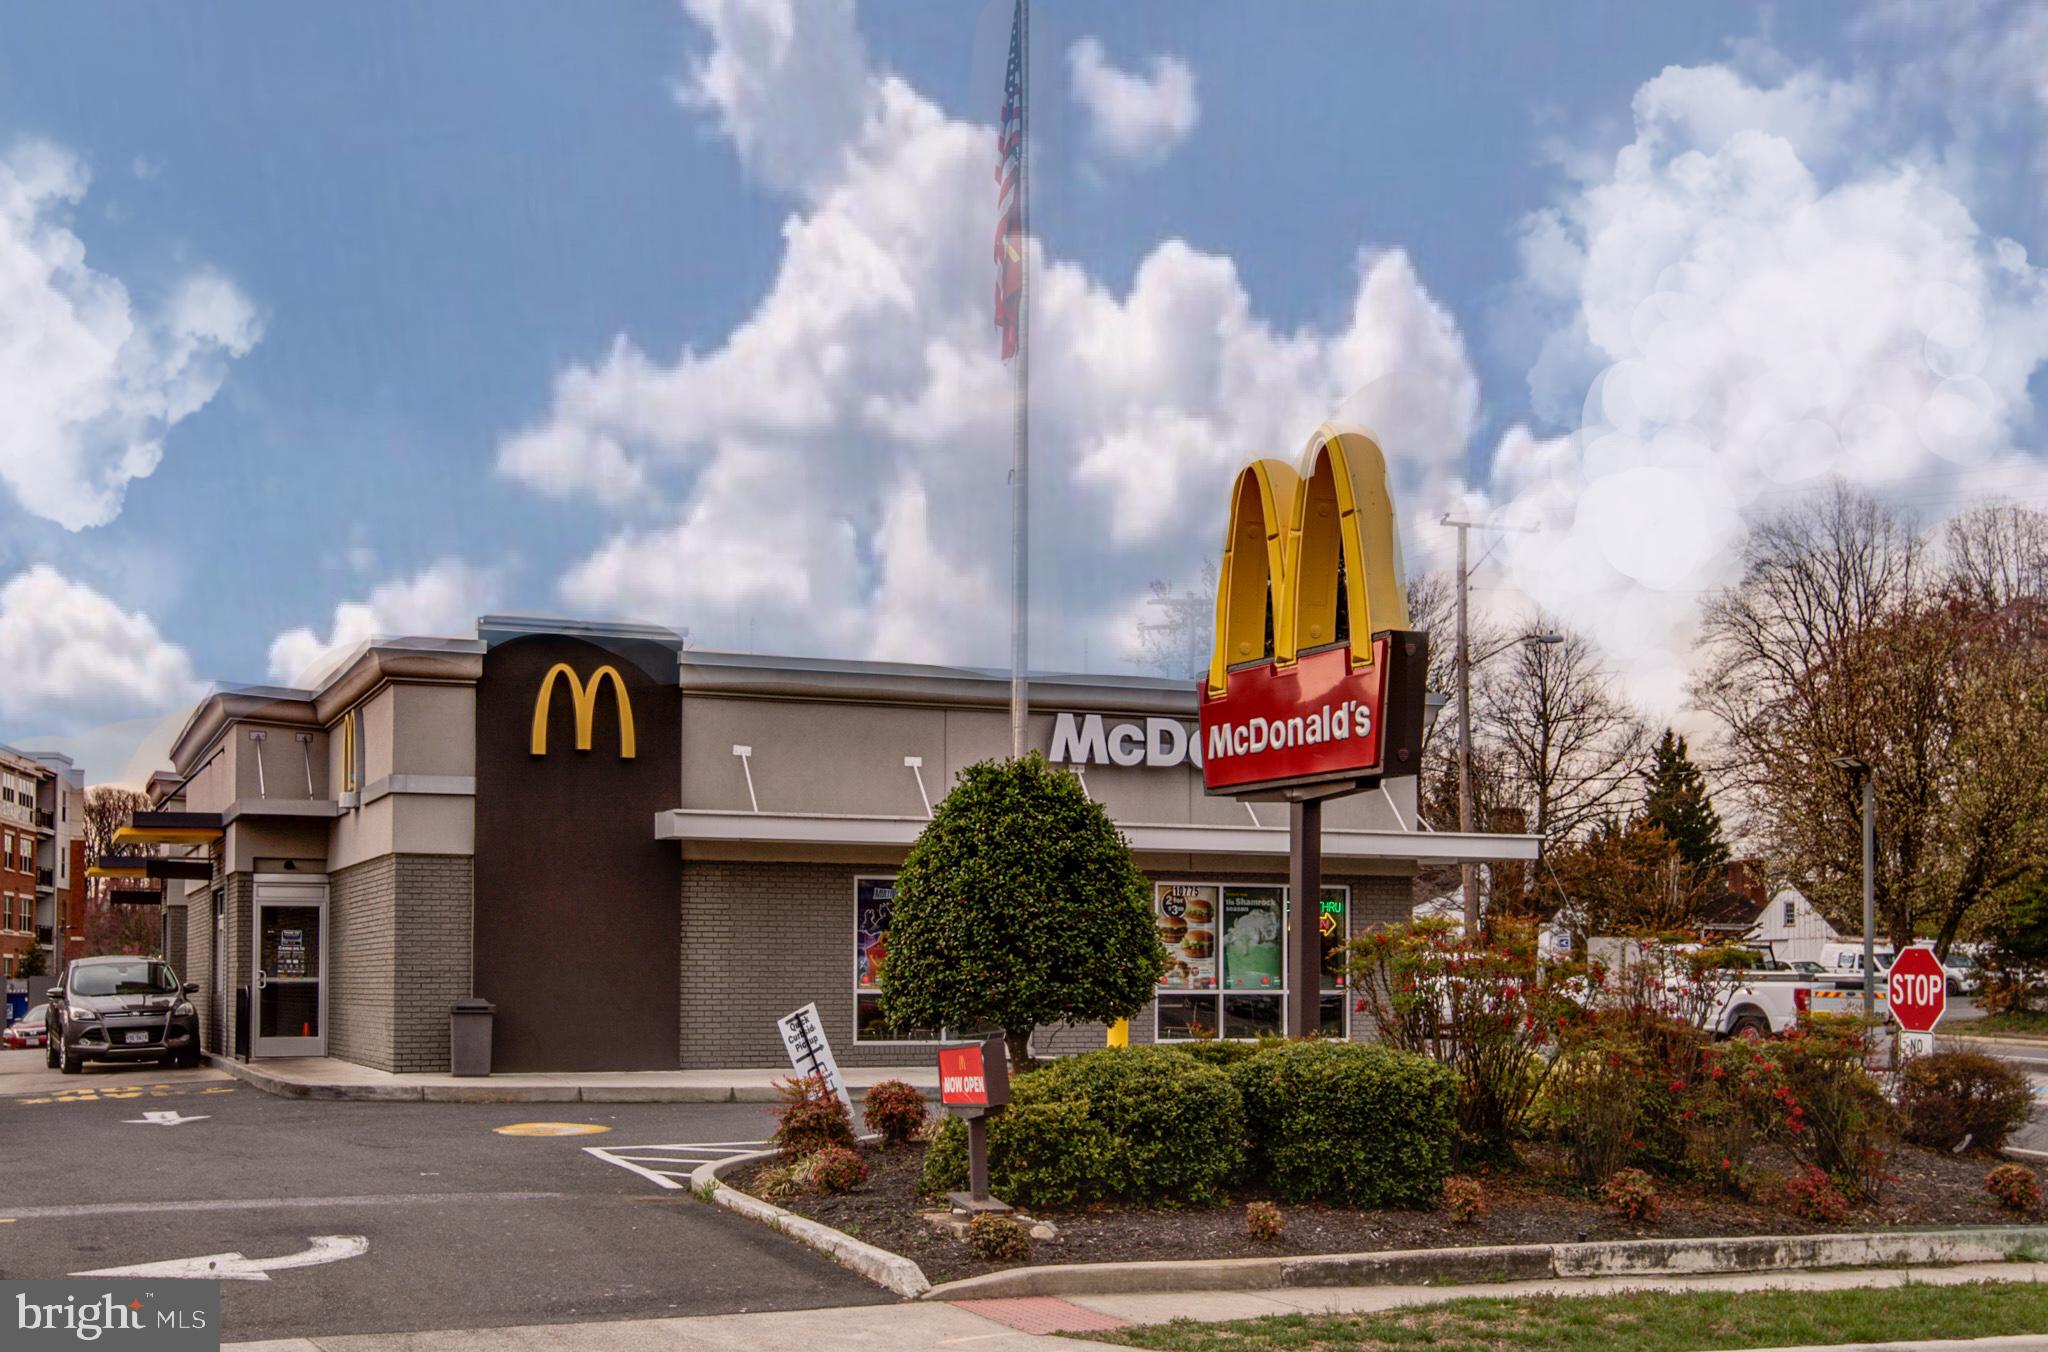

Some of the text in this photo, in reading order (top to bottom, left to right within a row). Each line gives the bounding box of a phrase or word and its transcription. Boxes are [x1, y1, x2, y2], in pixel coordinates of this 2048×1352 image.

[1208, 700, 1370, 760] McDonald's
[1173, 886, 1200, 896] 10775
[1165, 895, 1173, 905] 2
[1235, 897, 1276, 906] Shamrock
[1892, 973, 1942, 1006] STOP
[1910, 1038, 1923, 1054] NO
[944, 1076, 985, 1093] NOW OPEN
